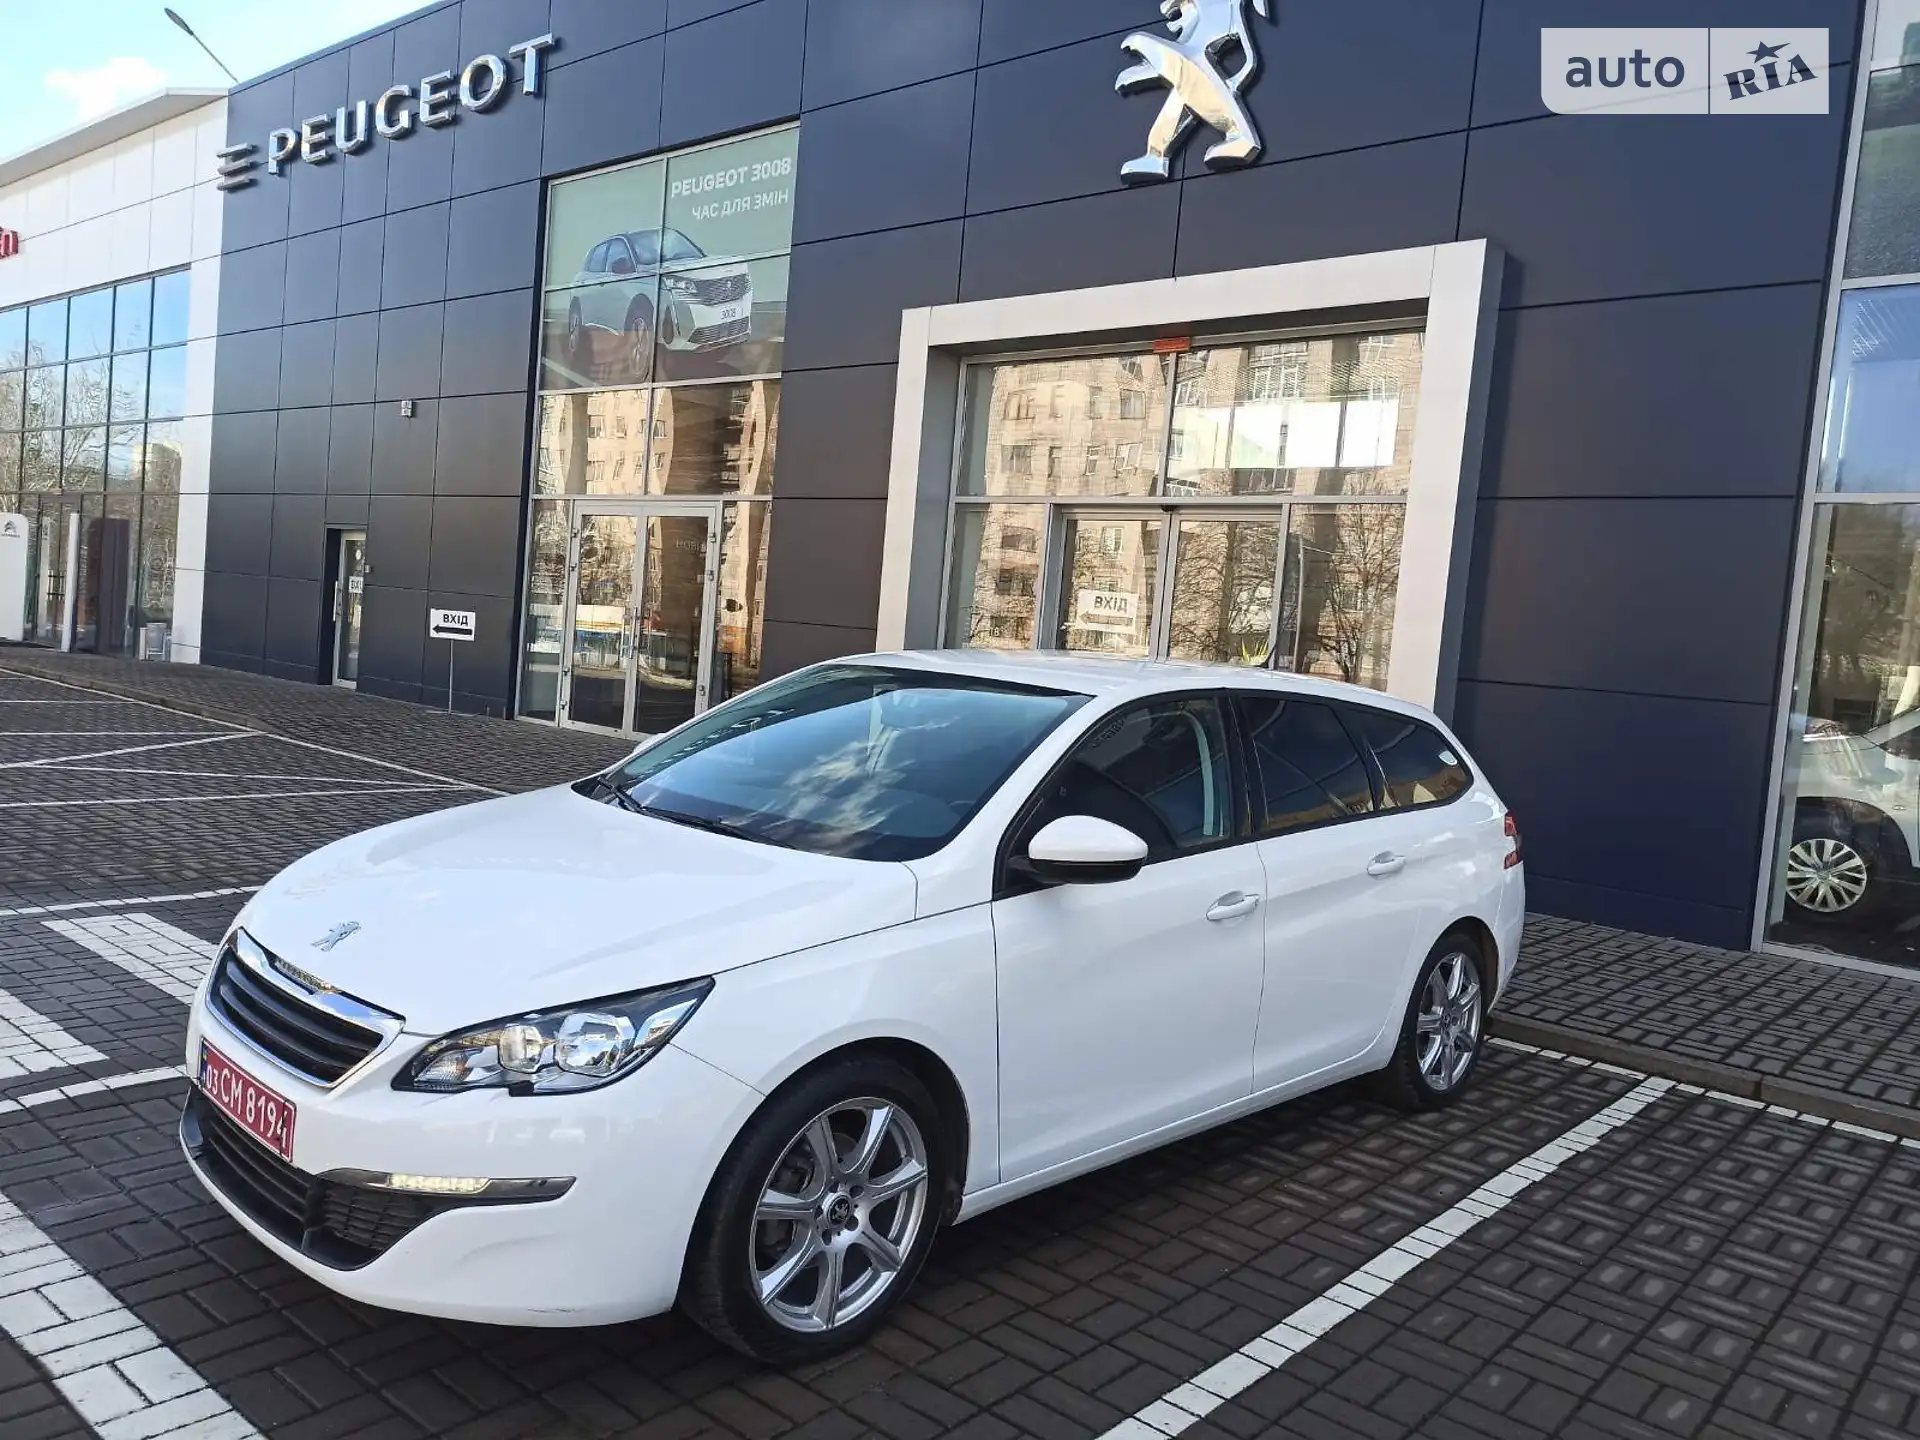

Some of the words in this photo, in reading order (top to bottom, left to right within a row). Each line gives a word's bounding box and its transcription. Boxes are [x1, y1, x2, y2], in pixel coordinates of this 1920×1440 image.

[268, 33, 555, 175] PEUGEOT
[671, 166, 748, 198] PEUGEOT
[751, 157, 792, 182] 3008
[692, 203, 719, 220] ЧАС
[720, 196, 751, 218] ДЛЯ
[753, 188, 789, 210] ЗМІН
[443, 613, 469, 627] ВХІД
[1094, 595, 1128, 613] ВХІД
